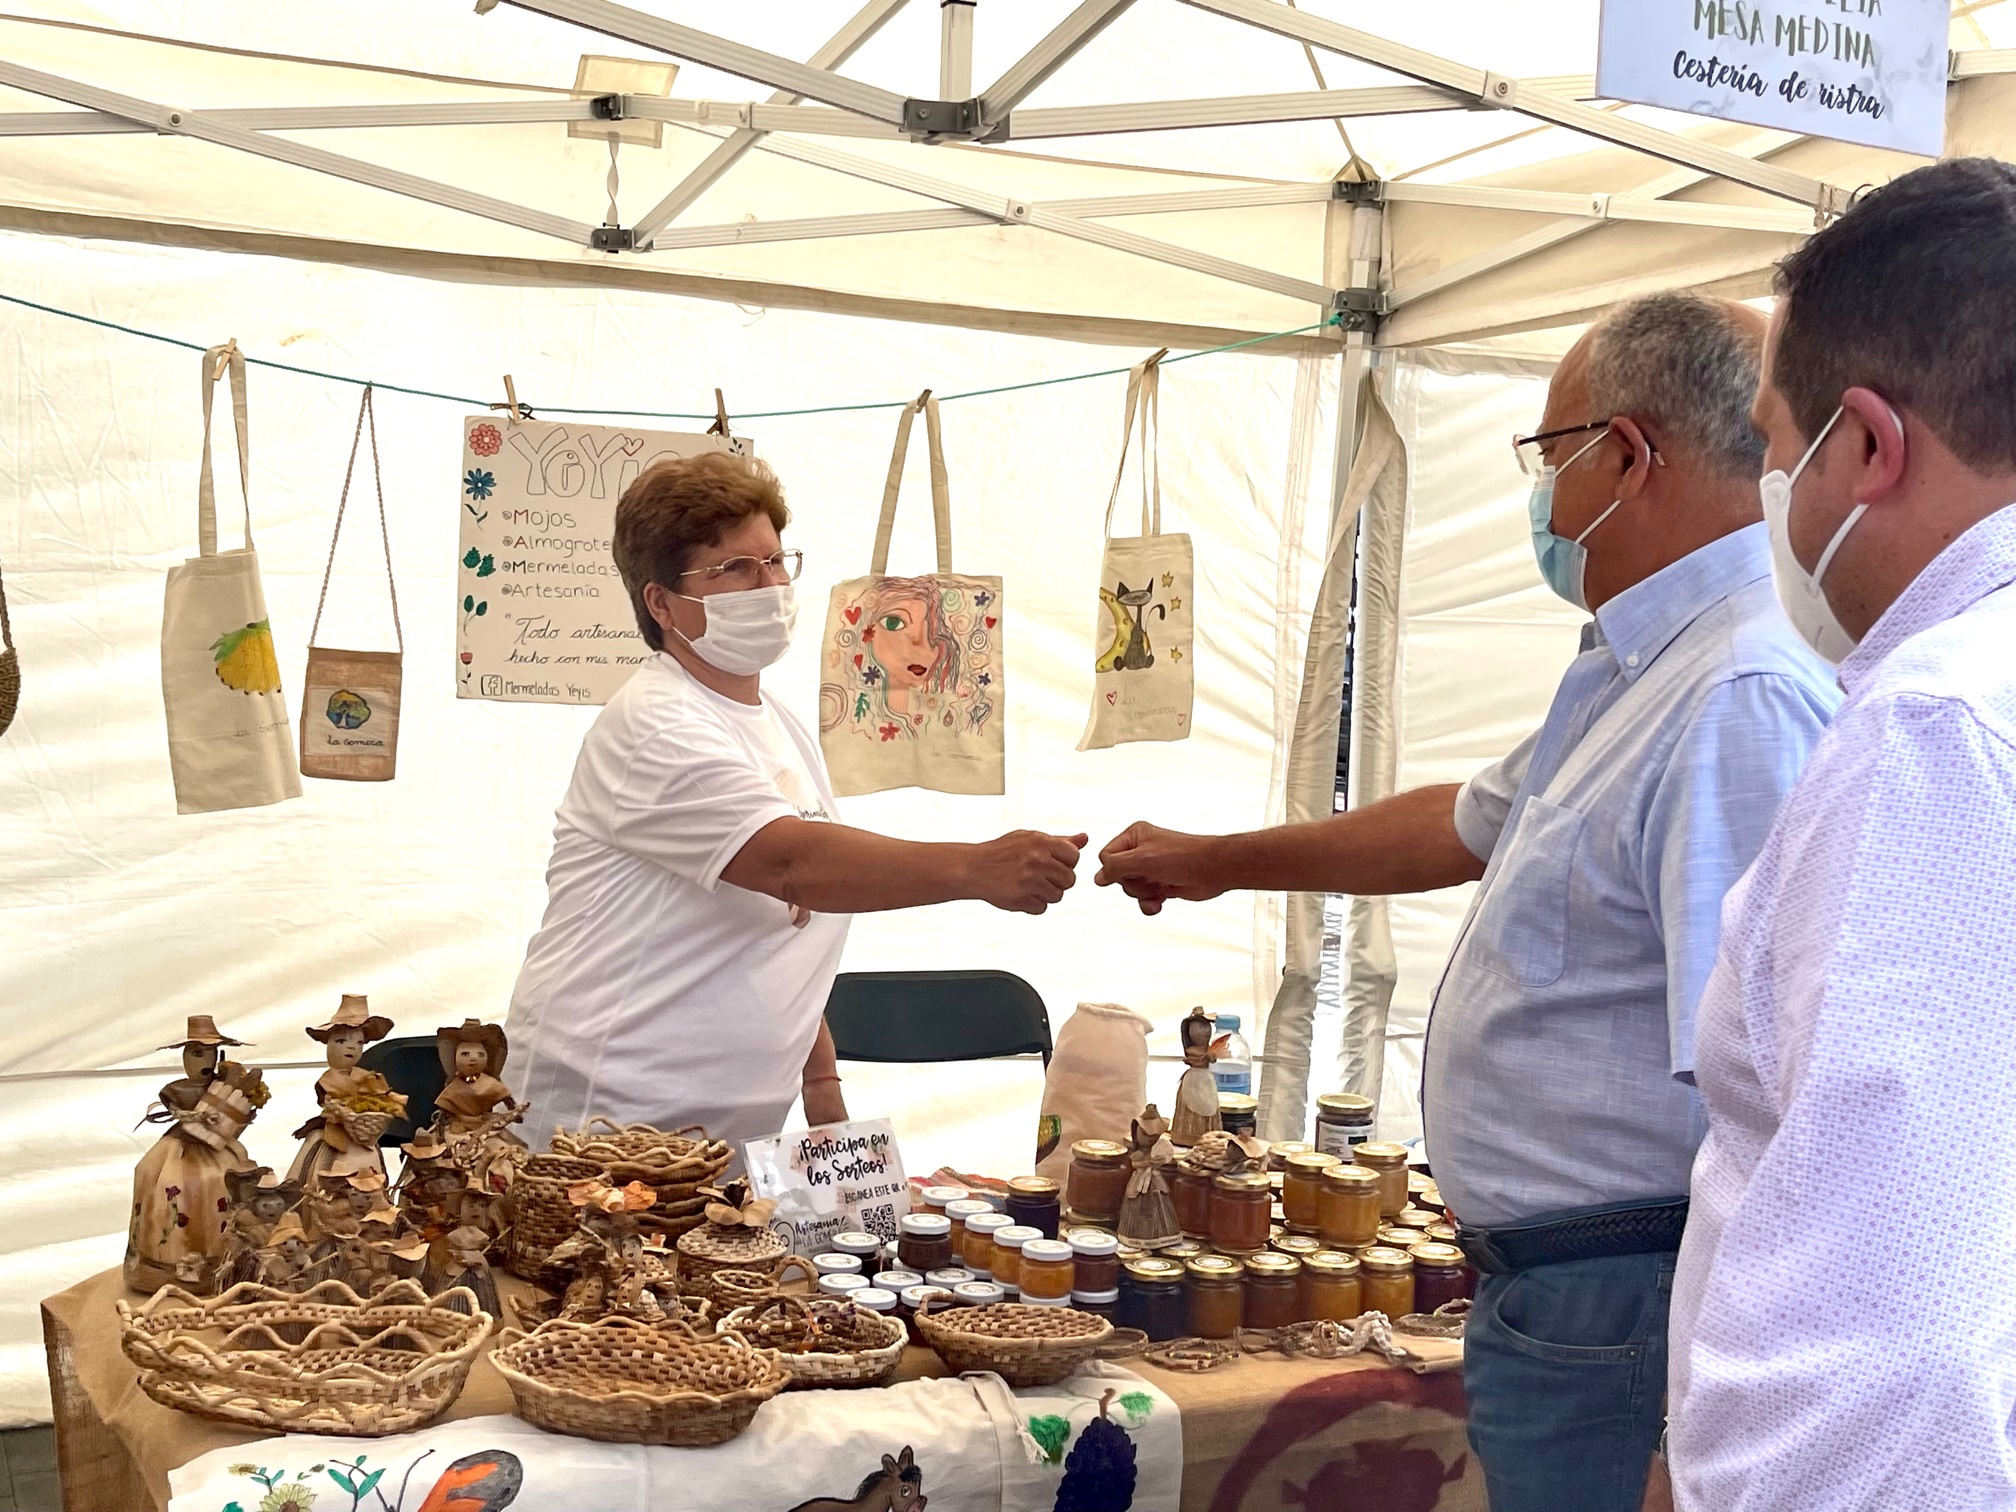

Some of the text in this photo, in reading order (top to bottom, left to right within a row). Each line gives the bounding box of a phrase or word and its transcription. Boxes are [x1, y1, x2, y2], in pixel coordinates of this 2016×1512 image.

[1694, 0, 1875, 69] MESA MEDINA
[1778, 71, 1808, 104] de
[1819, 83, 1886, 120] ristra
[513, 509, 577, 533] Mojos
[513, 535, 611, 558] Almogrote
[512, 560, 620, 577] Mermeladas
[504, 649, 549, 664] hecho
[554, 655, 581, 664] con
[586, 656, 608, 665] mis
[505, 681, 560, 696] Mermeladas
[565, 683, 591, 701] Yeyis
[870, 1133, 889, 1147] en
[806, 1152, 888, 1187] los Sorteos!
[844, 1187, 874, 1204] ESCANEA
[874, 1184, 891, 1198] ESTE
